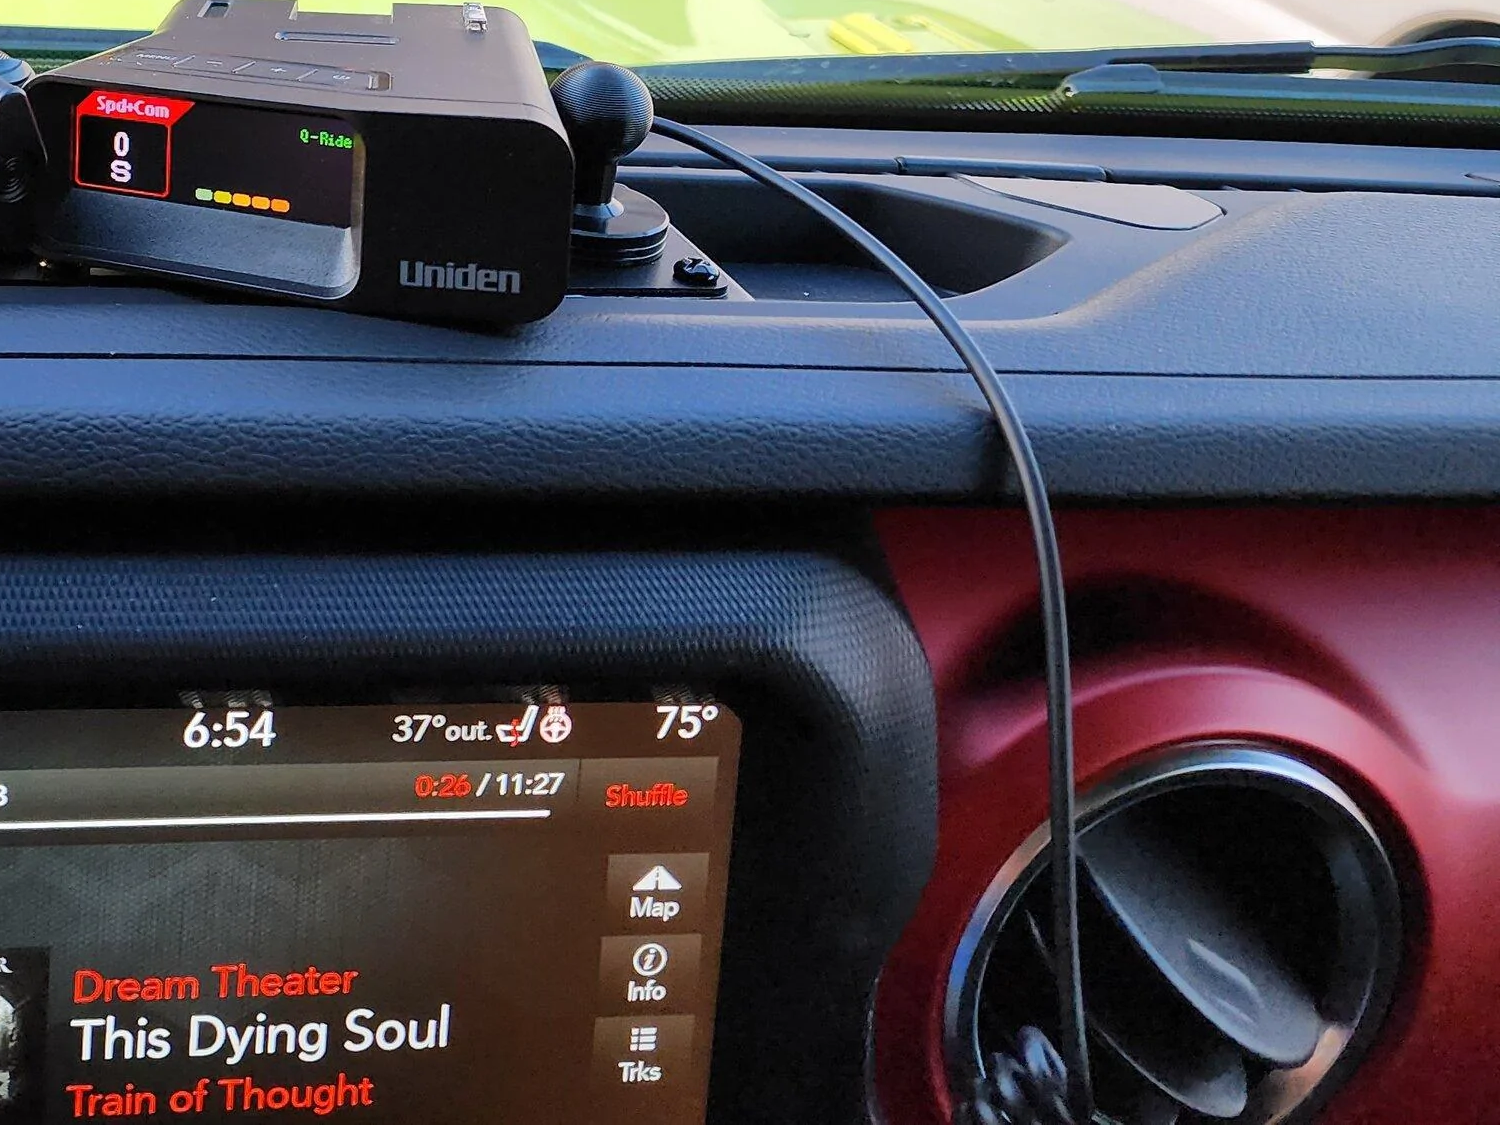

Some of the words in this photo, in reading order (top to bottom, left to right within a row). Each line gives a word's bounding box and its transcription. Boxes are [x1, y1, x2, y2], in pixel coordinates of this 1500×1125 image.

[299, 128, 354, 149] Q-Ride
[110, 159, 132, 183] S
[399, 260, 520, 295] Uniden
[183, 711, 277, 748] 6:54
[414, 774, 472, 798] 0:26
[496, 772, 566, 796] 11:27
[605, 783, 688, 808] Shuffle
[629, 896, 680, 922] Map
[73, 969, 199, 1004] Dream
[211, 962, 358, 999] Theater
[627, 980, 667, 1003] Info
[70, 1015, 171, 1061] This
[188, 1013, 328, 1065] Dying
[343, 1004, 450, 1052] Soul
[618, 1061, 662, 1083] Trks
[66, 1083, 156, 1118] Train
[169, 1079, 208, 1114] of
[219, 1073, 375, 1115] Thought
